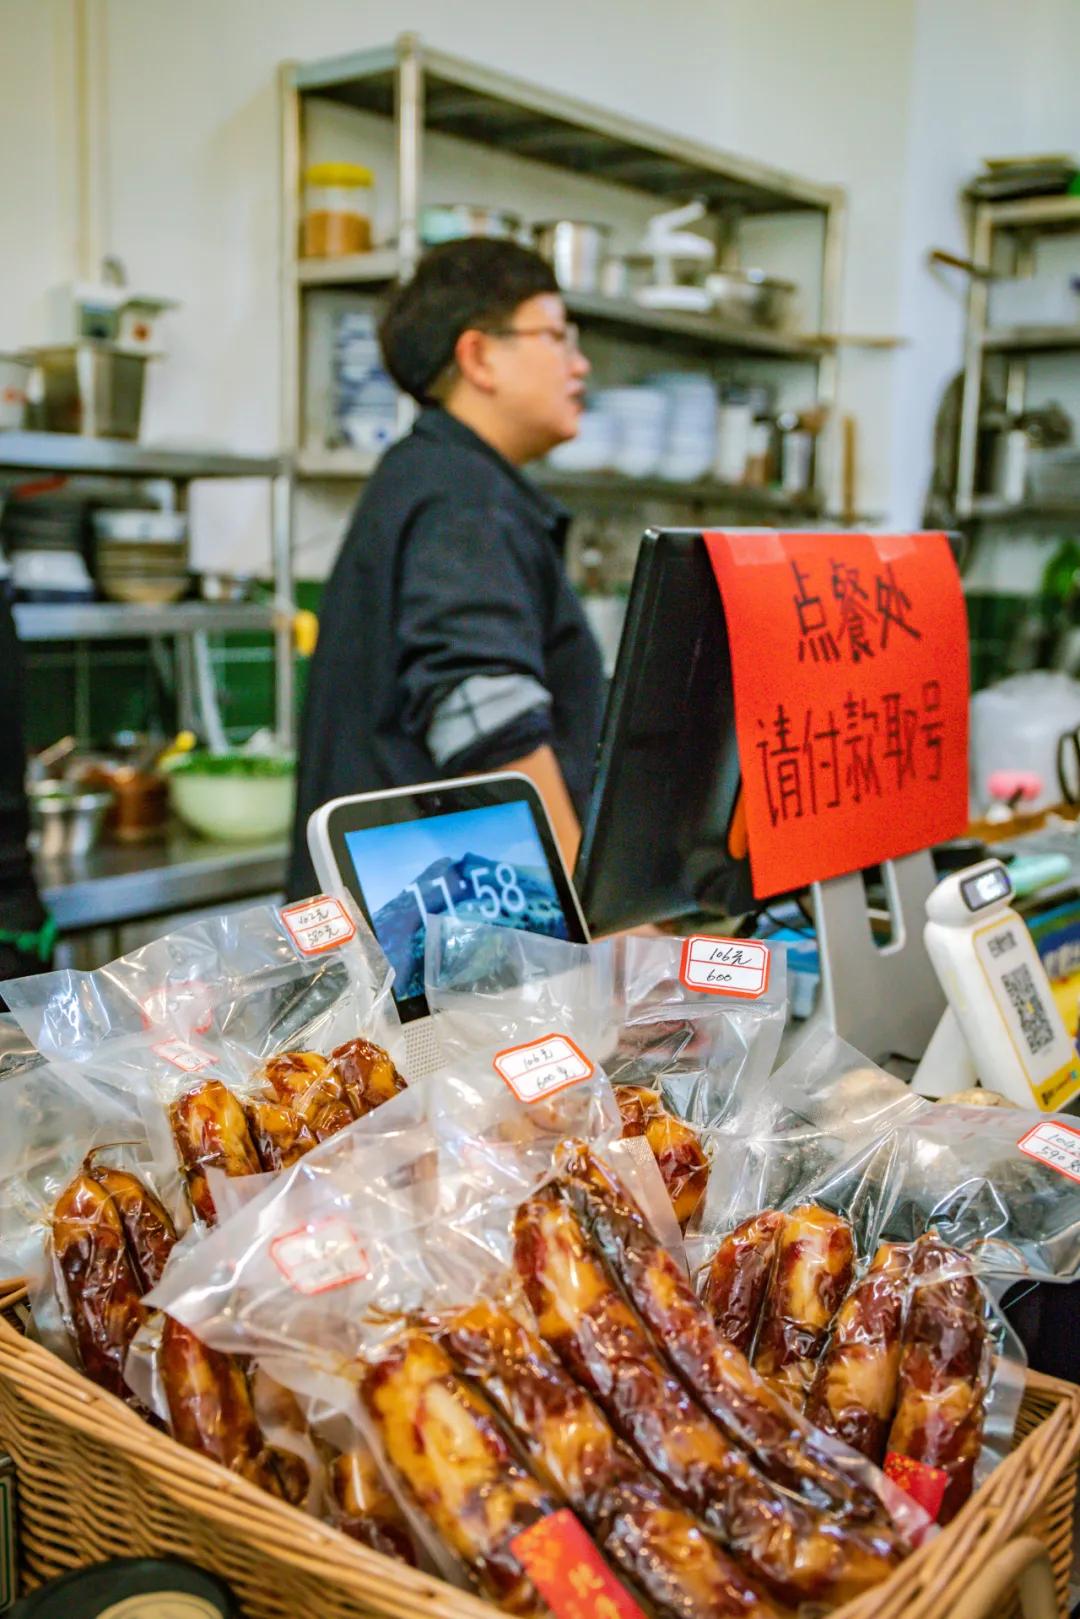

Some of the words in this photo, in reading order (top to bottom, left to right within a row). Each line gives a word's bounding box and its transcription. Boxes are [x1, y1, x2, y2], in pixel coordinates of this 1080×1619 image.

[790, 557, 922, 663] 点餐处
[756, 679, 944, 827] 请付款取号
[405, 863, 527, 926] 11:58
[706, 968, 733, 982] 600
[709, 947, 752, 966] 106元
